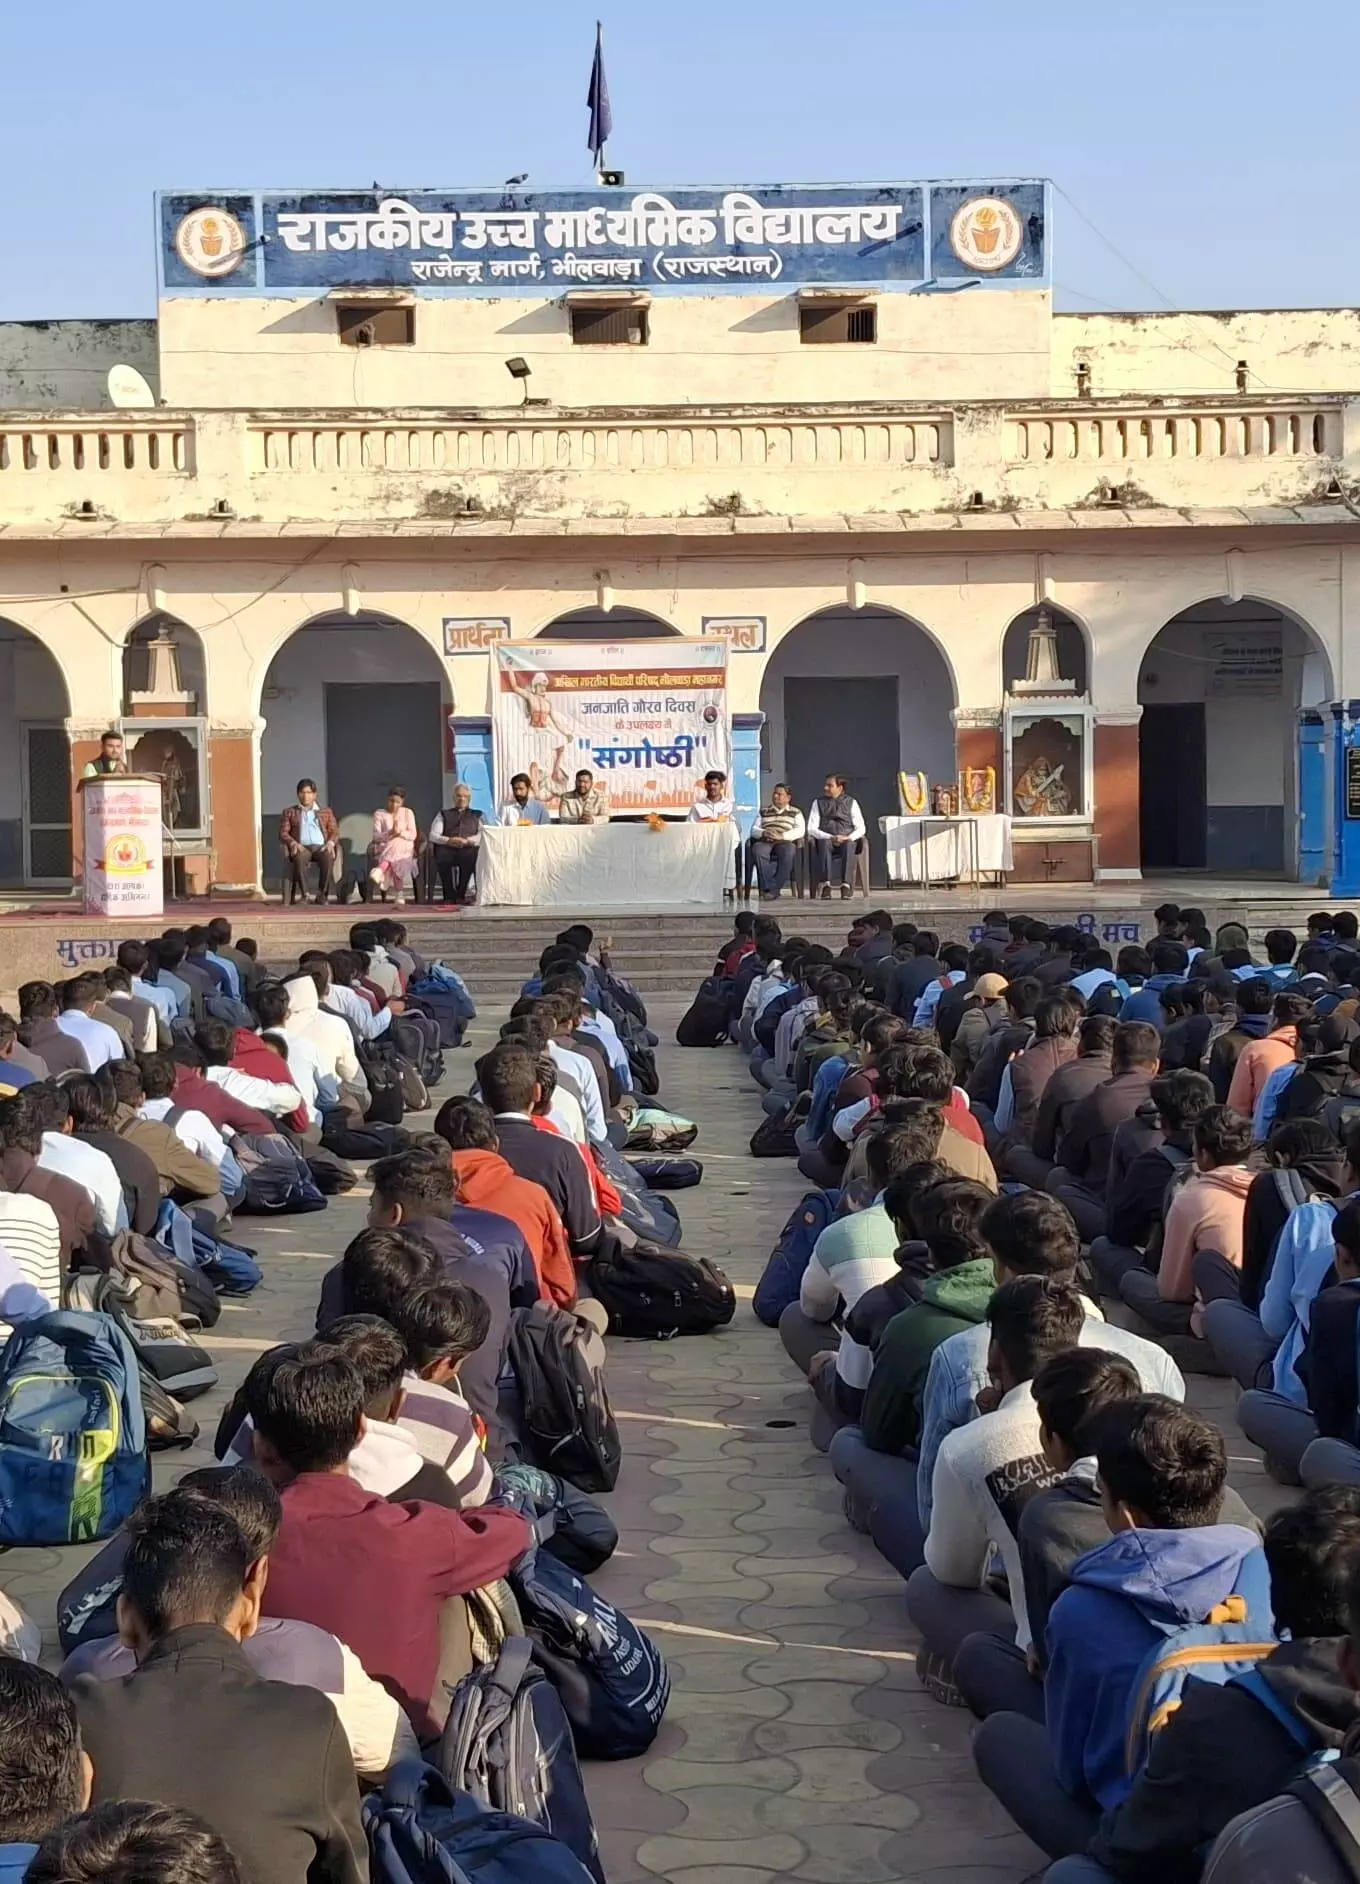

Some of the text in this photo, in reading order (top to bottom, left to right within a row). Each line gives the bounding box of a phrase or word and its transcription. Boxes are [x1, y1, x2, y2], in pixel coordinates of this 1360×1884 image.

[277, 192, 903, 251] राजकीय उच्च माध्यमिक विद्यालय
[411, 254, 484, 284] राजेन्द्र
[550, 252, 643, 282] भीलवाड़ा
[652, 249, 783, 282] (राजस्थान)
[580, 698, 630, 715] जनजाति
[665, 697, 696, 714] दिवस
